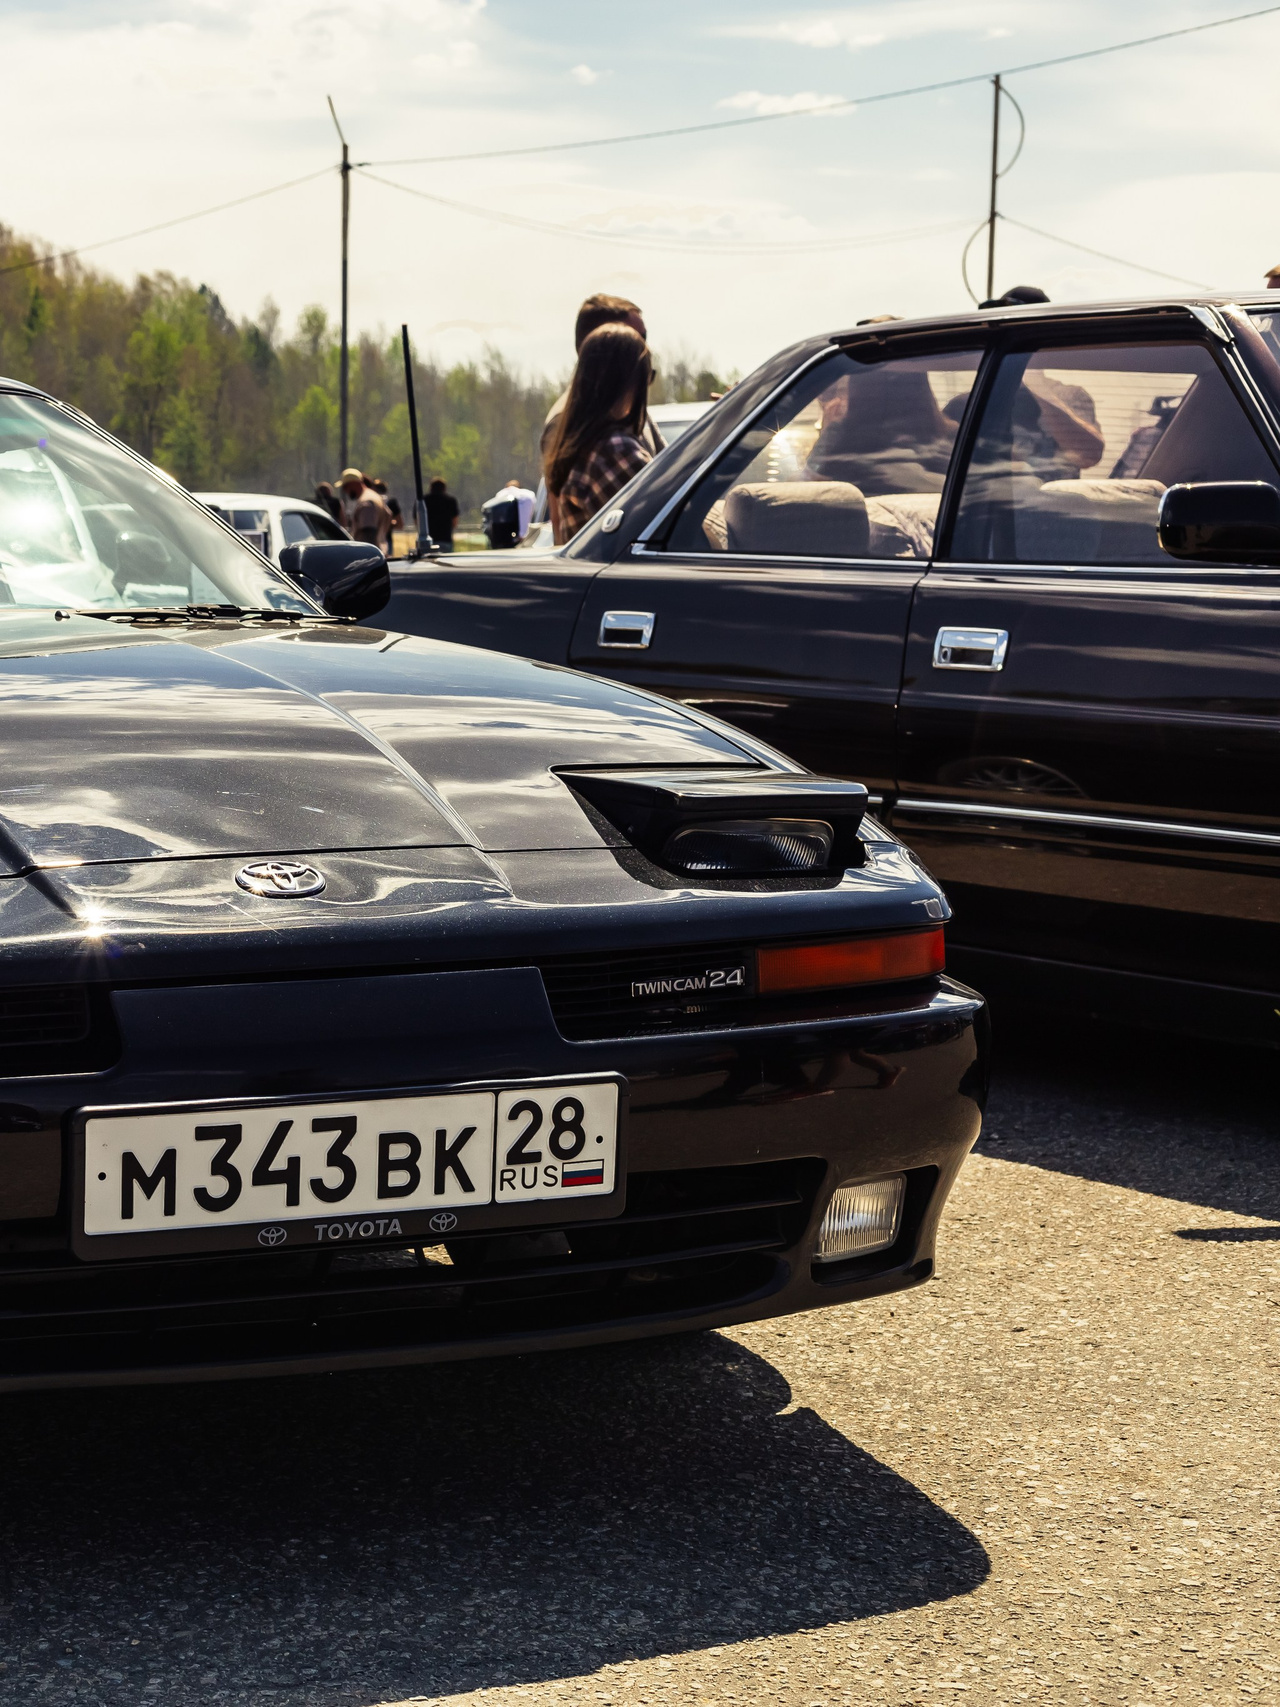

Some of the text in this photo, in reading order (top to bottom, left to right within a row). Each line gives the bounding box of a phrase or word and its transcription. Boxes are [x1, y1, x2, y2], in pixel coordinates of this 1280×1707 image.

[506, 1096, 586, 1166] 28
[500, 1164, 558, 1191] RUS
[314, 1218, 402, 1241] TOYOTA
